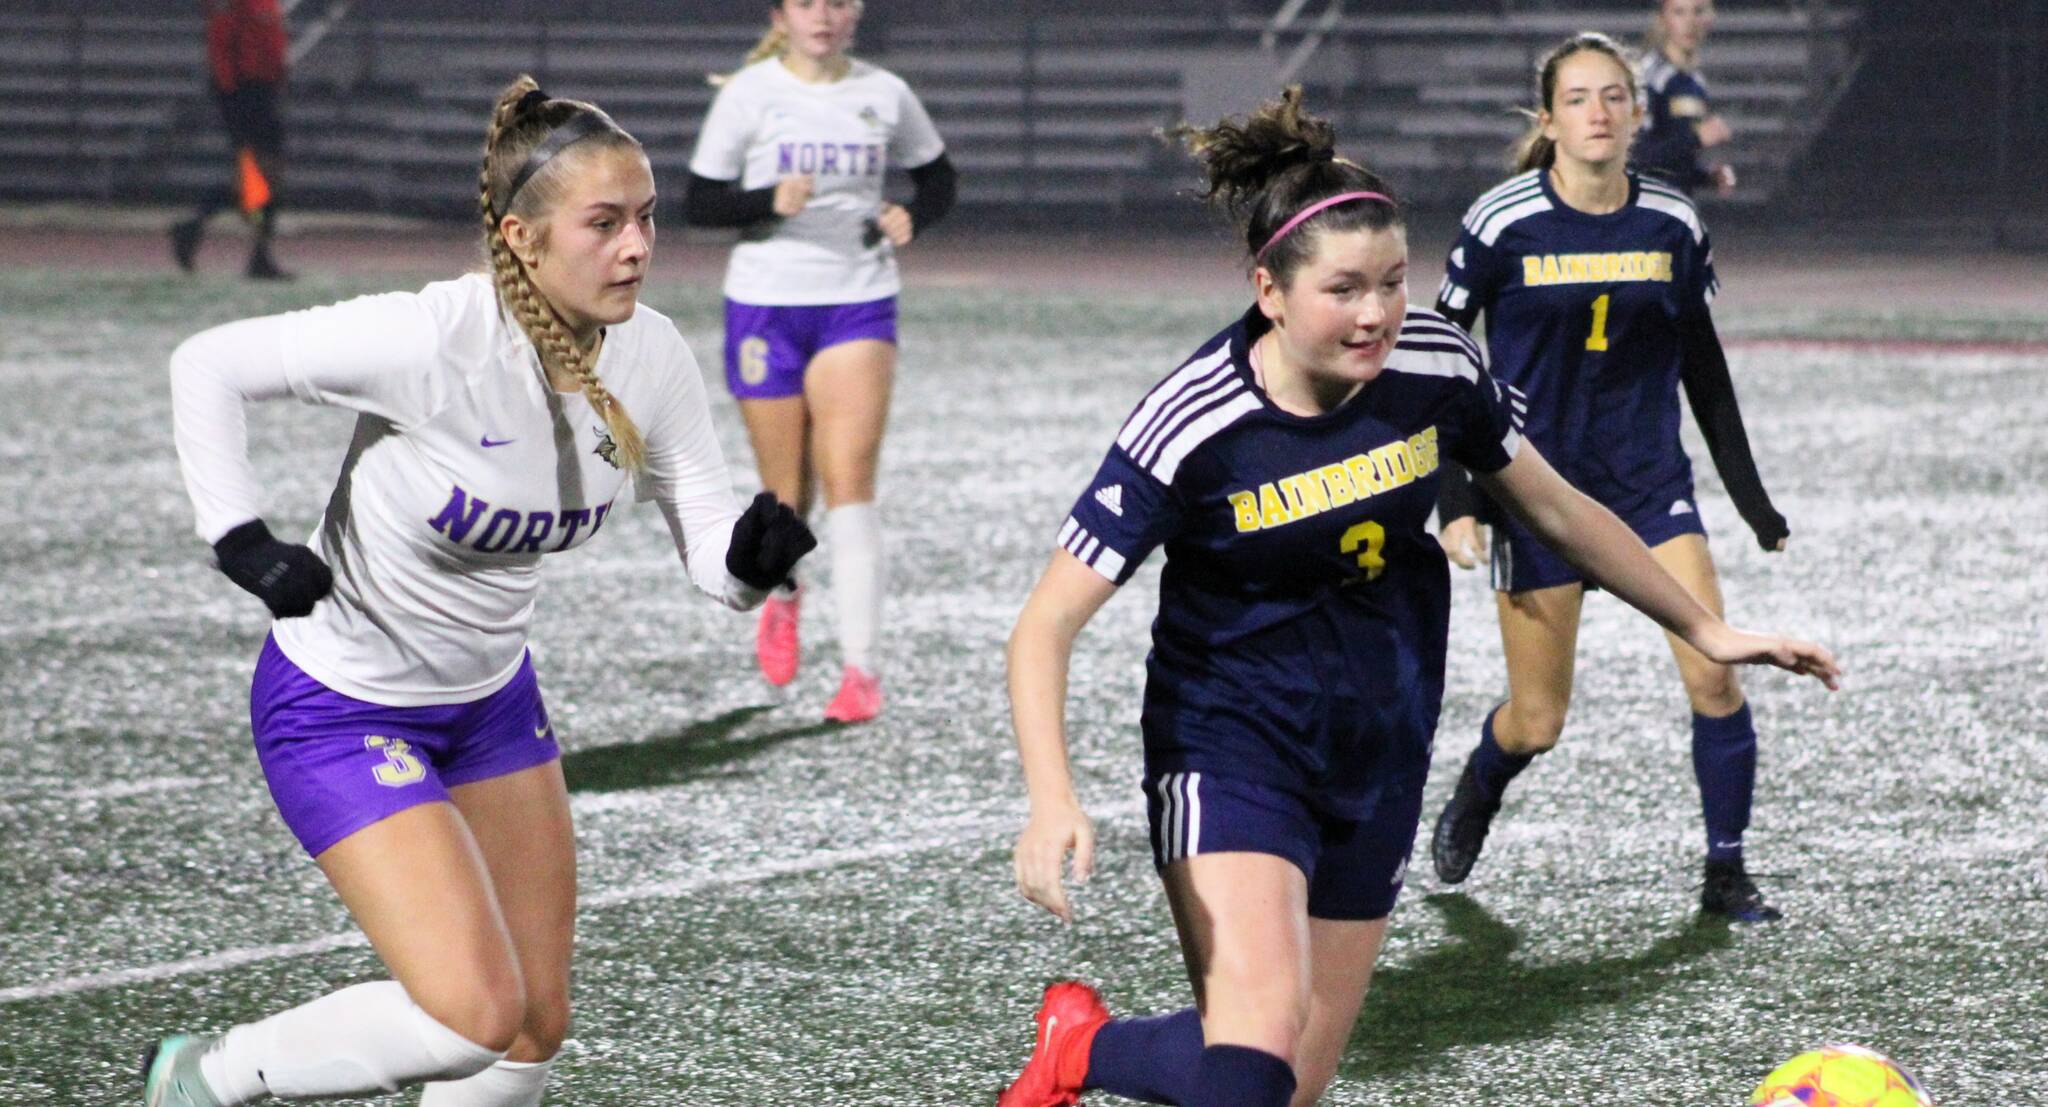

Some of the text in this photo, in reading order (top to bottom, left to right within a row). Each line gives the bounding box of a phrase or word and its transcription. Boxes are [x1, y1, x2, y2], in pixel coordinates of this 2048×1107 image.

[1522, 252, 1673, 286] BAINBRIDGE
[1585, 294, 1609, 351] 1
[740, 336, 769, 386] 6
[1227, 424, 1439, 533] BAINBRIDGE
[1340, 520, 1386, 587] 3
[364, 734, 426, 788] 3
